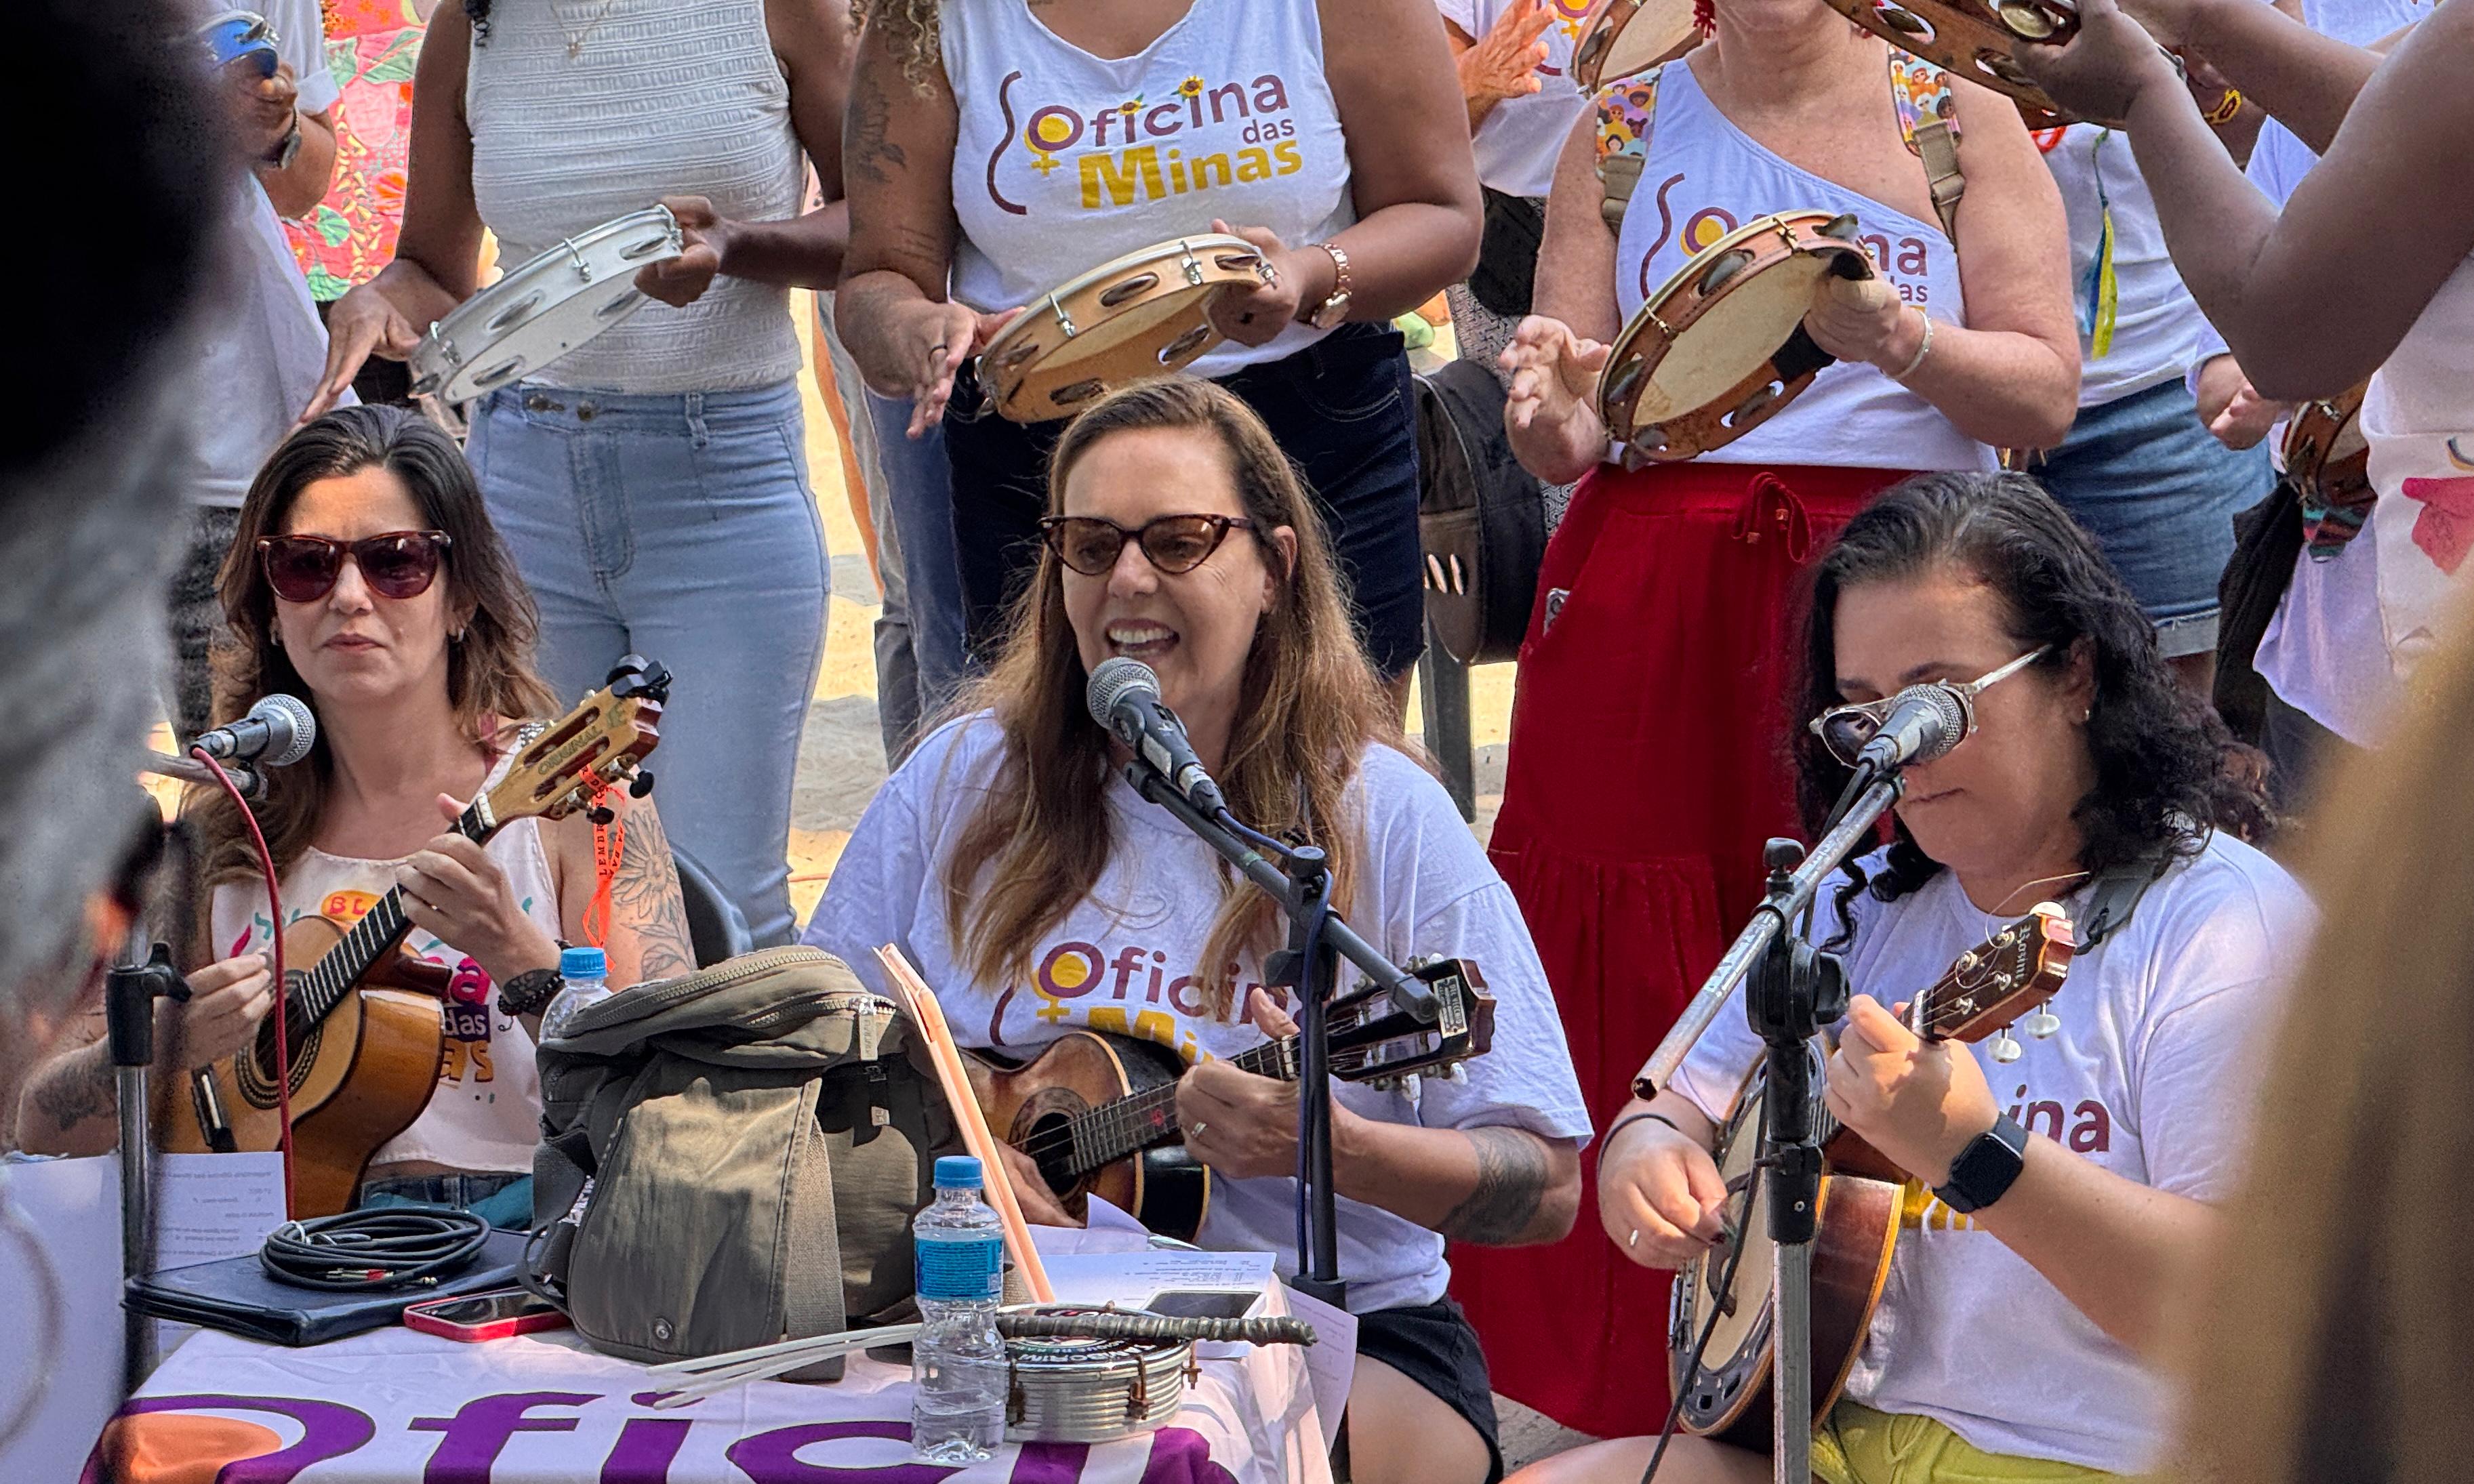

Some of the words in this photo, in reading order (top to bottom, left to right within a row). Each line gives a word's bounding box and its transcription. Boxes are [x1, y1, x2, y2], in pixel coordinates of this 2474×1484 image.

[1028, 74, 1290, 152] Oficina
[1242, 118, 1295, 145] das
[1078, 139, 1303, 209] Minas
[1038, 942, 1302, 1025] Oficin
